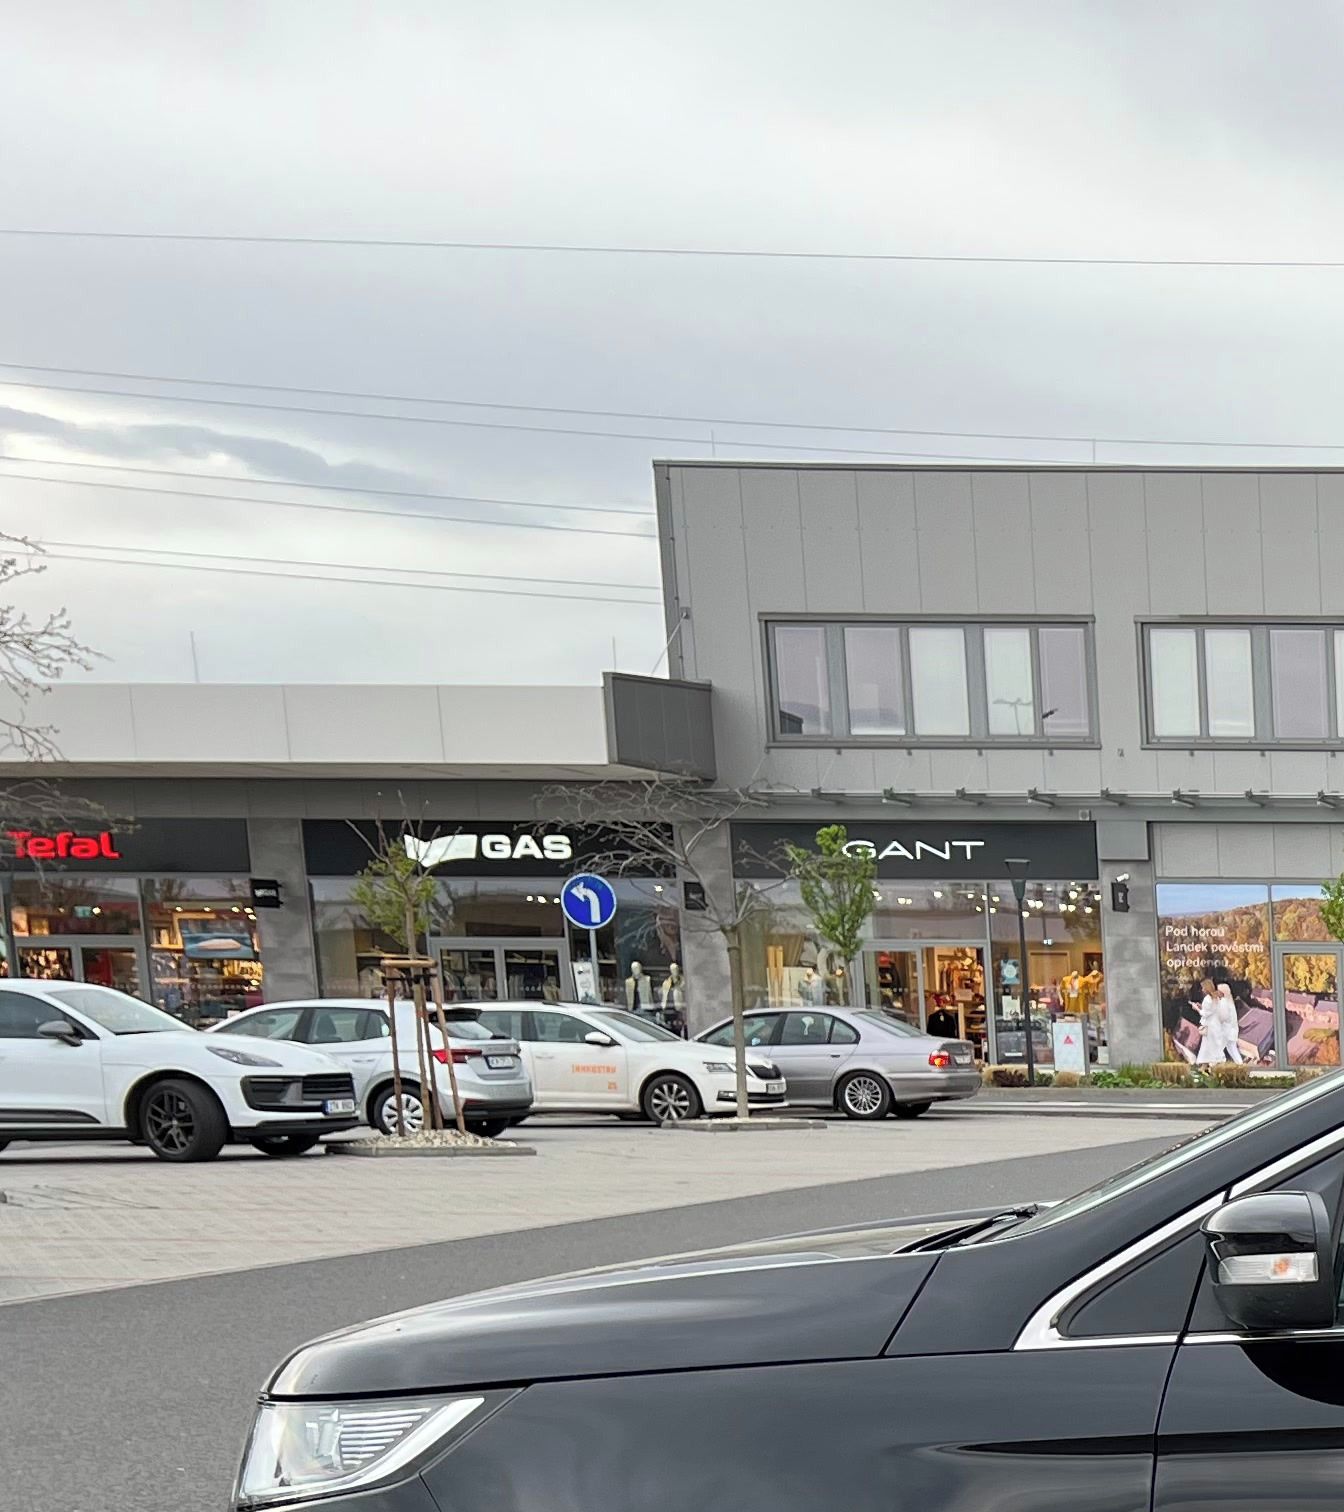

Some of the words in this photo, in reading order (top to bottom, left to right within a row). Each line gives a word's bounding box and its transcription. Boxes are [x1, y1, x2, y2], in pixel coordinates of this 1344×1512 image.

[5, 830, 121, 859] Tefal
[481, 834, 572, 860] GAS
[842, 840, 985, 860] GANT
[1165, 925, 1188, 937] Pod
[1191, 926, 1225, 937] horou
[1166, 941, 1208, 952] Landek
[1211, 941, 1265, 953] pověstmi
